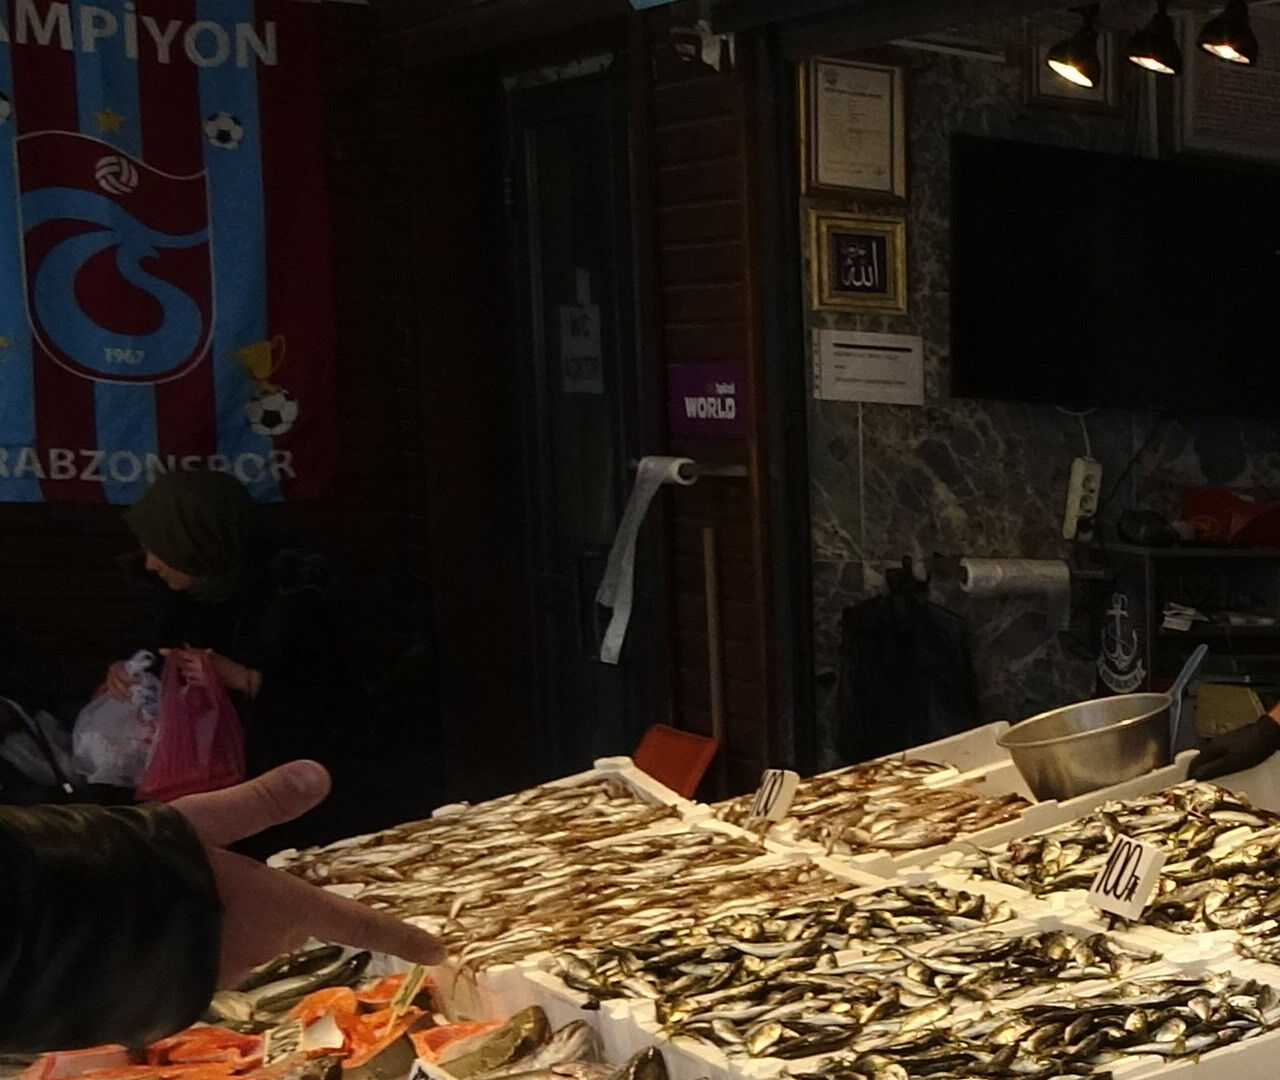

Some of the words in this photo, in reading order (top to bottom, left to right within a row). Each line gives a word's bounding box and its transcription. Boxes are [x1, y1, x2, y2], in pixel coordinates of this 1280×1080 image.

[0, 0, 279, 68] MPİYON
[684, 396, 736, 420] WORLD
[1095, 838, 1144, 900] 100
